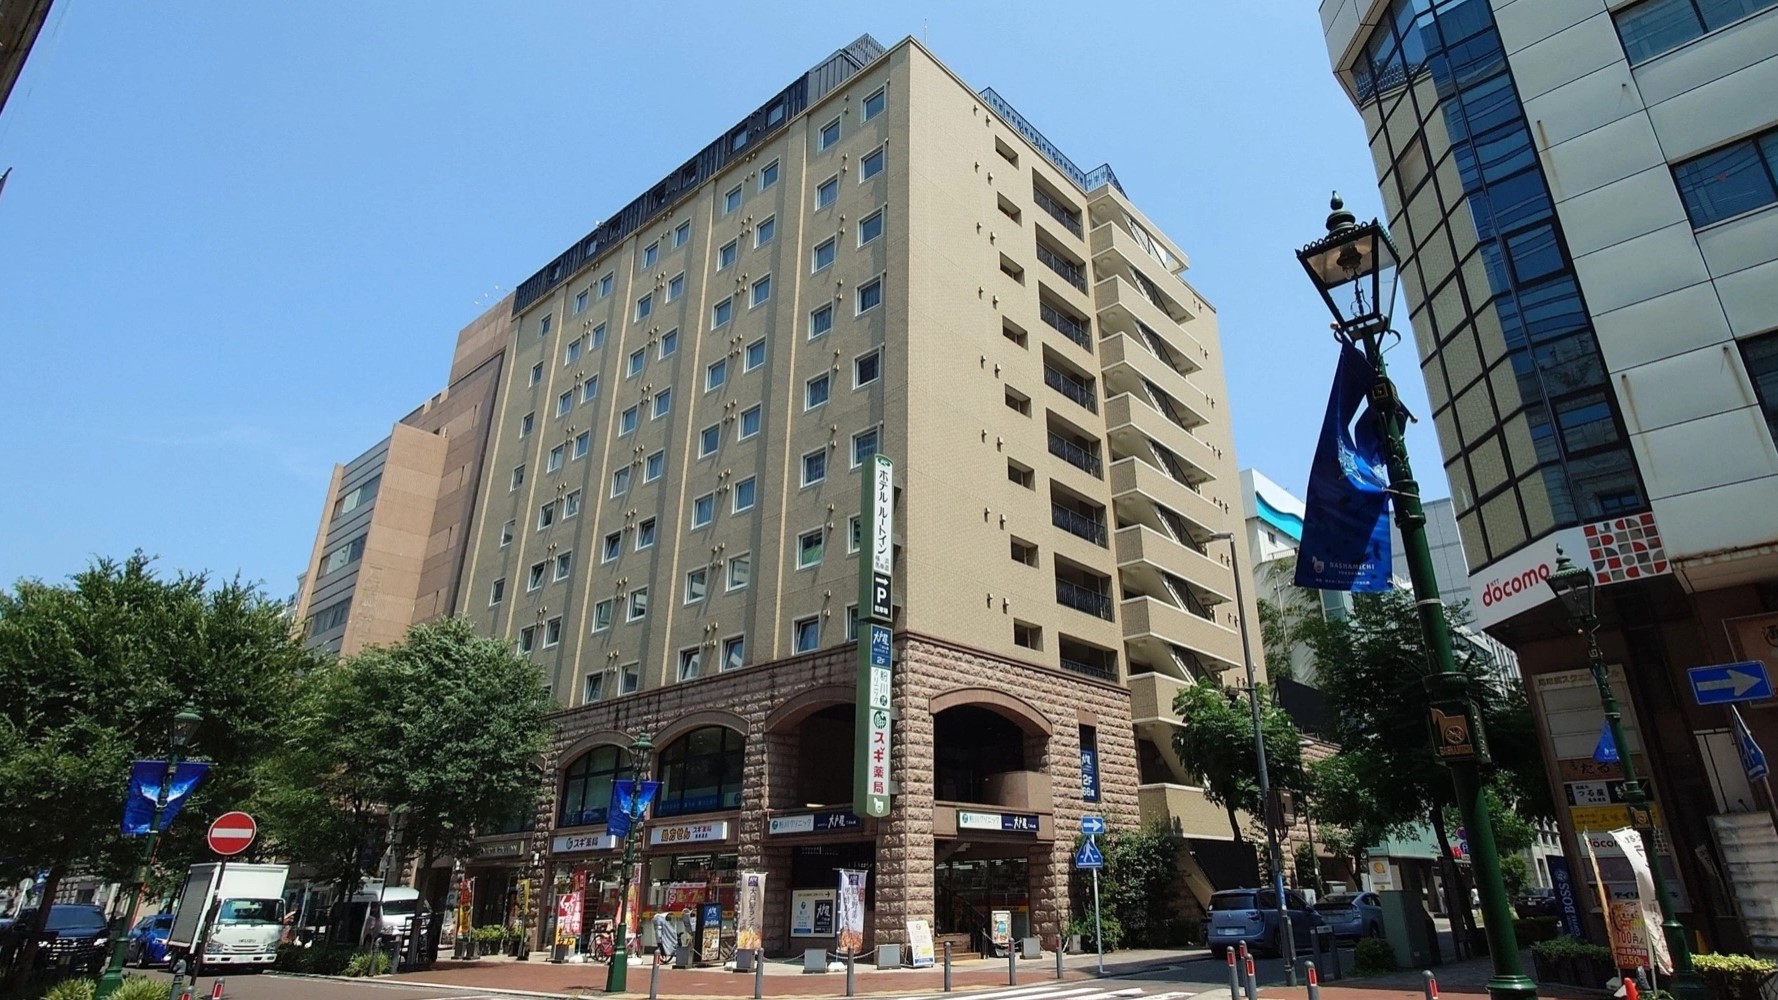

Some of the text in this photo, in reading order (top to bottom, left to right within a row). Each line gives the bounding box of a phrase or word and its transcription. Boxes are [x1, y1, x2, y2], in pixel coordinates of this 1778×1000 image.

[878, 469, 888, 554] ホテル ルートイン
[1329, 561, 1375, 570] BASHAMICHI
[877, 586, 887, 604] P
[1482, 563, 1550, 607] docomo
[873, 731, 885, 794] スギ薬局
[1082, 774, 1093, 786] 2F
[573, 836, 599, 848] スギ薬局
[1558, 882, 1576, 914] BOSS
